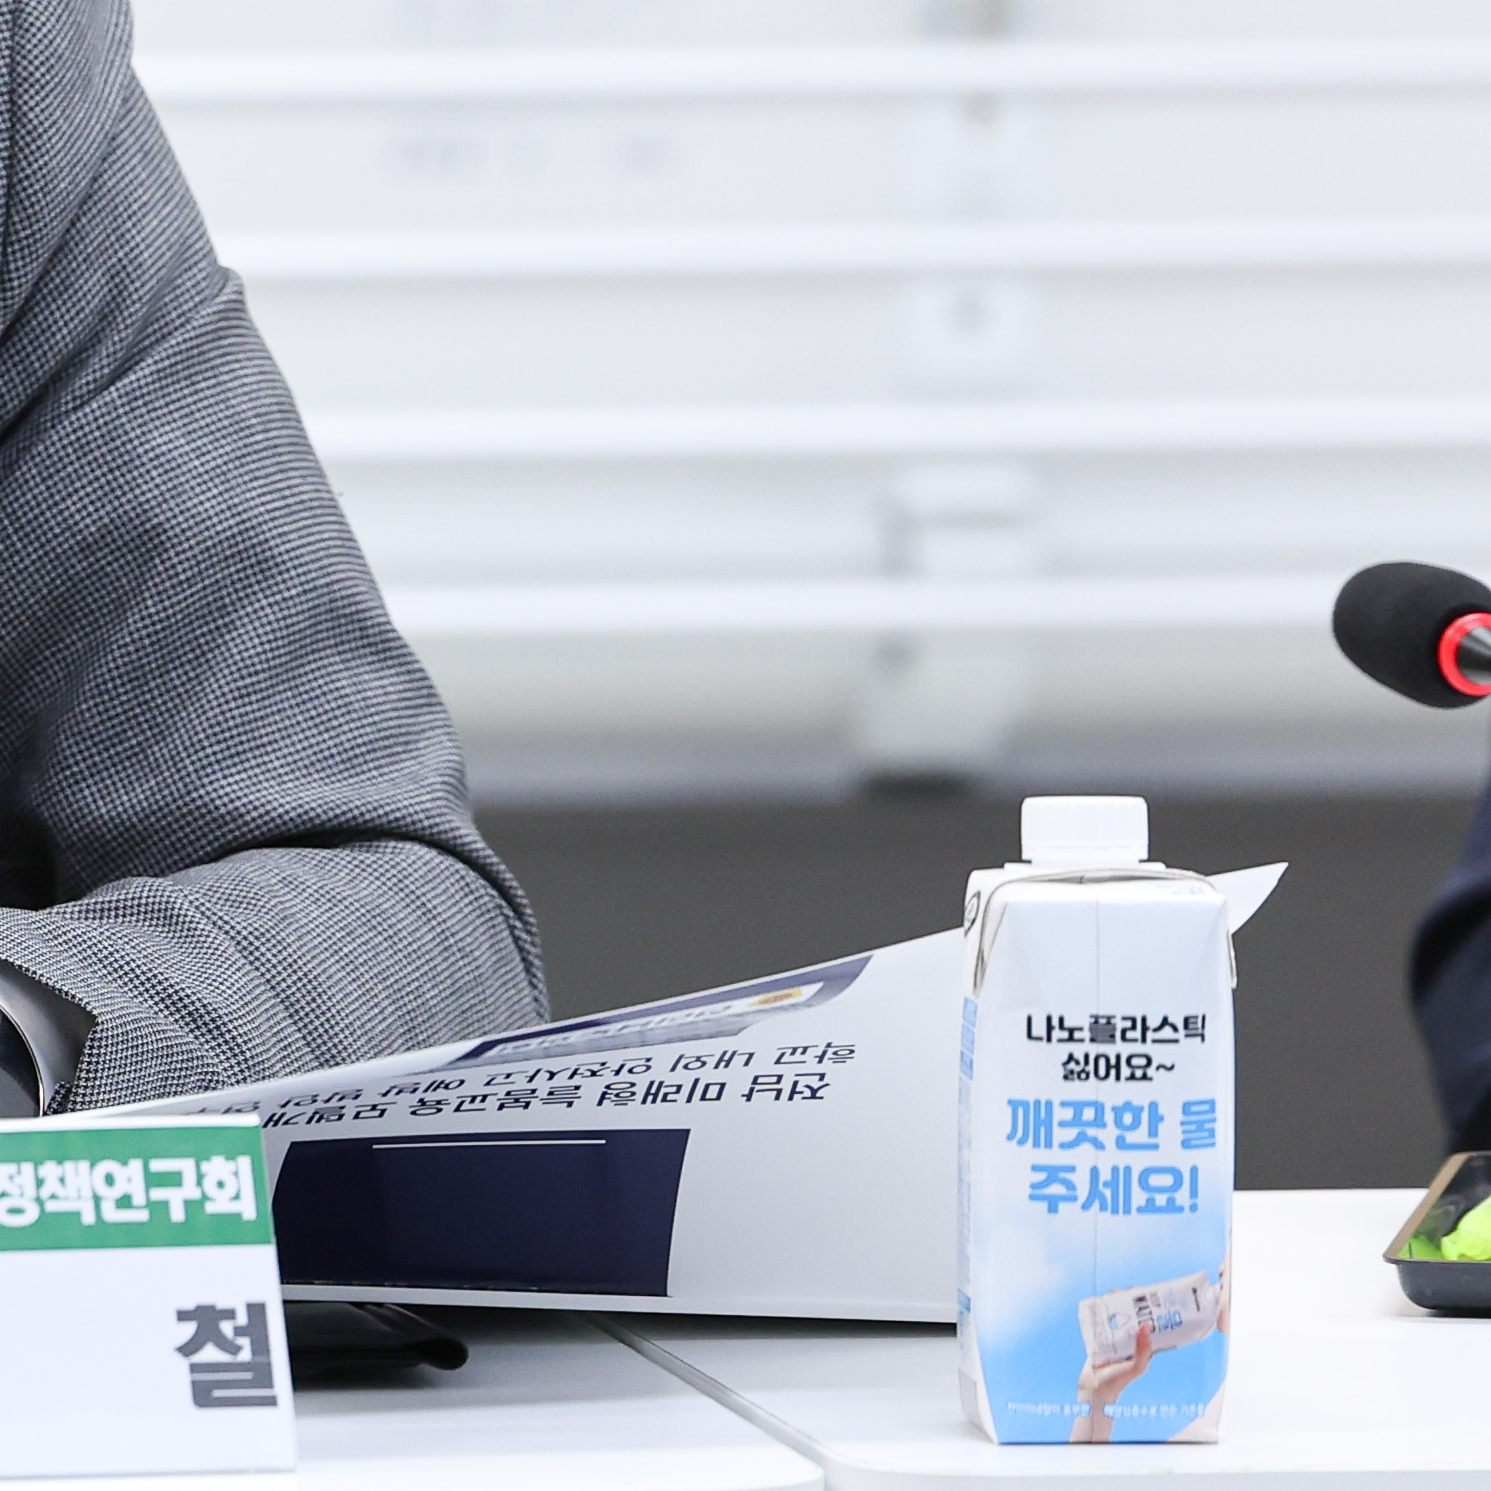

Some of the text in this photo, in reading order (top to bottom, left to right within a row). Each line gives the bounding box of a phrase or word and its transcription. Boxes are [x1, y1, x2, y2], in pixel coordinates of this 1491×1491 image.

[1026, 1013, 1206, 1044] 나노플라스틱
[670, 1049, 755, 1073] 내외
[774, 1042, 855, 1065] 학교
[1061, 1052, 1175, 1082] 싫어요~
[484, 1057, 653, 1087] 안전사고
[409, 1085, 582, 1117] 늘봄교육
[596, 1078, 727, 1107] 미래형
[741, 1073, 830, 1102] 전남
[1006, 1097, 1217, 1151] 깨끗한 물
[1028, 1164, 1199, 1215] 주세요!
[174, 1302, 278, 1407] 철
